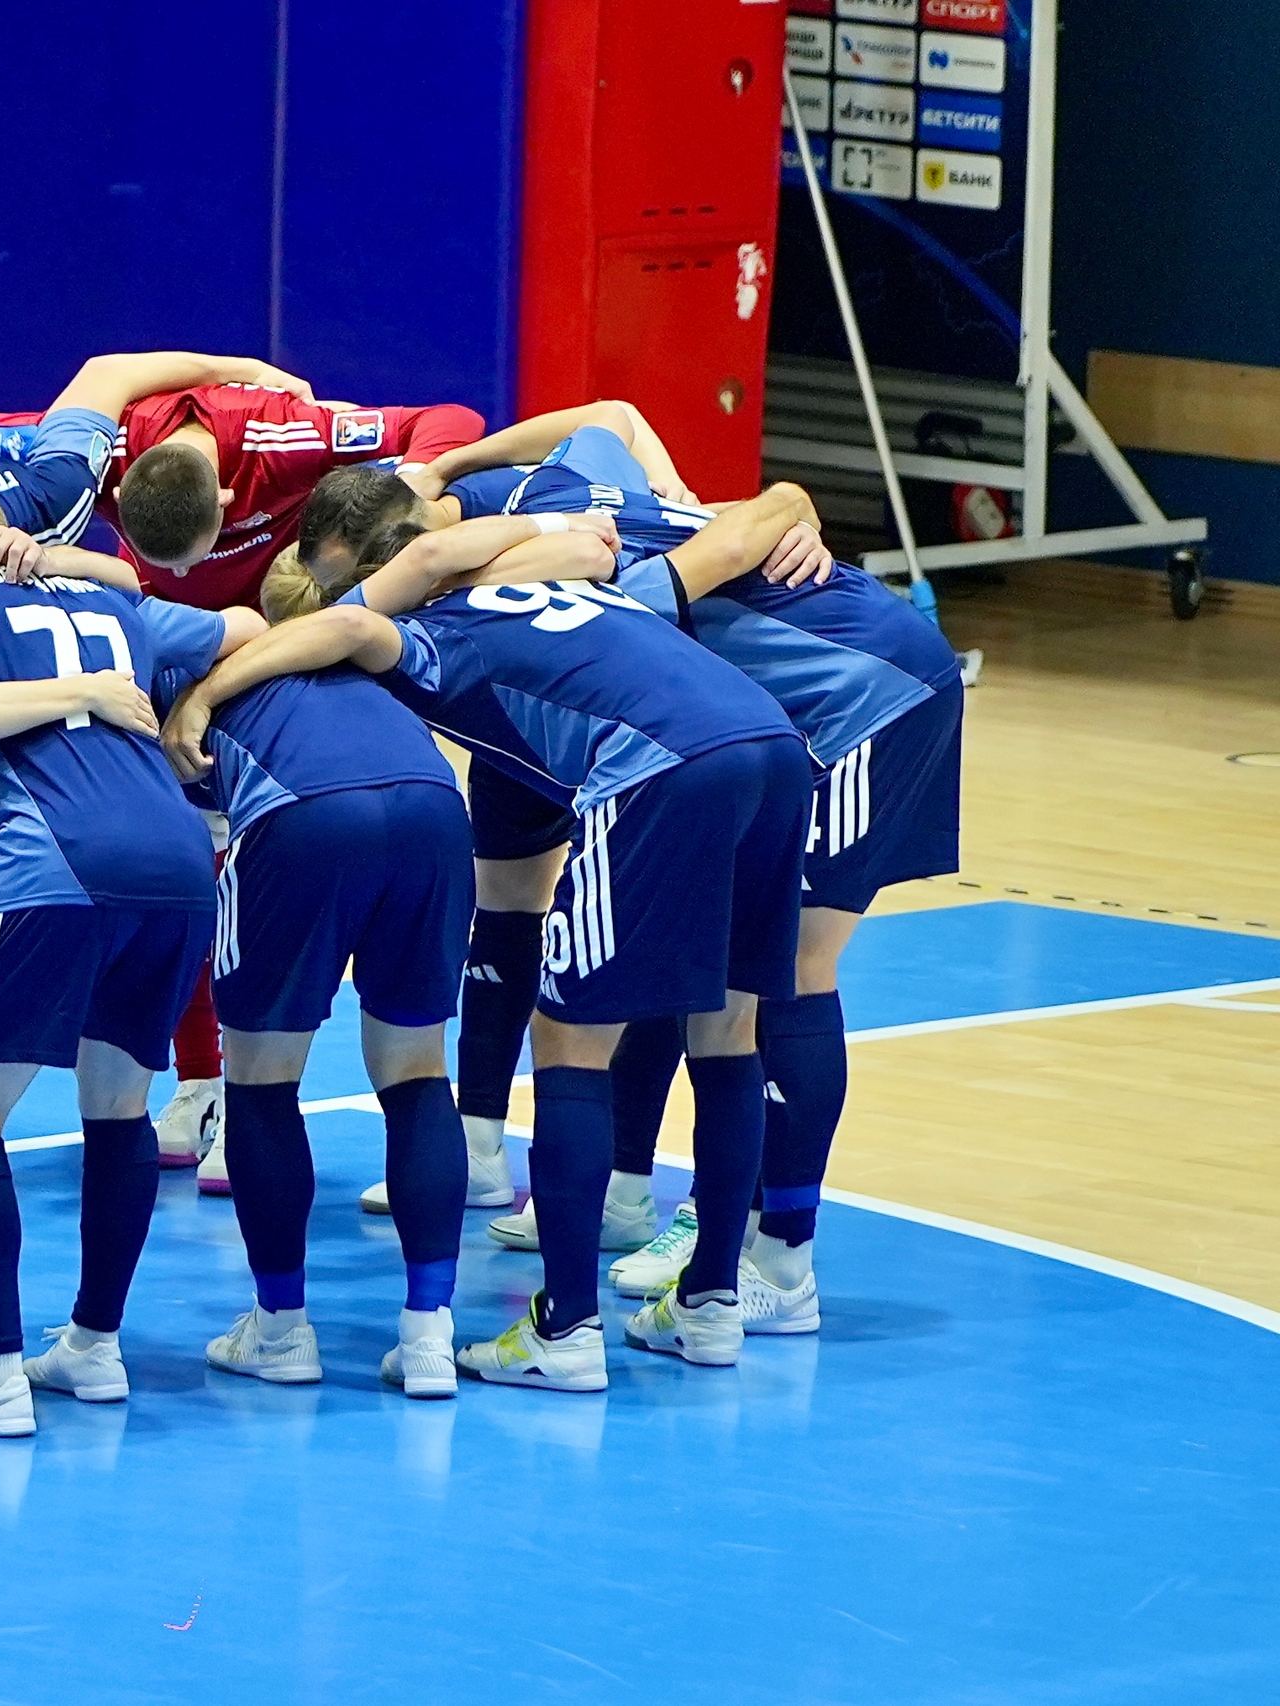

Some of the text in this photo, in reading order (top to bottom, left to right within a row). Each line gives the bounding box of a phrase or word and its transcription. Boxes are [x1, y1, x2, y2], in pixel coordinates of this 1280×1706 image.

[922, 108, 1001, 133] БЕТСИТИ
[948, 169, 994, 189] БАНК
[5, 604, 136, 730] 77
